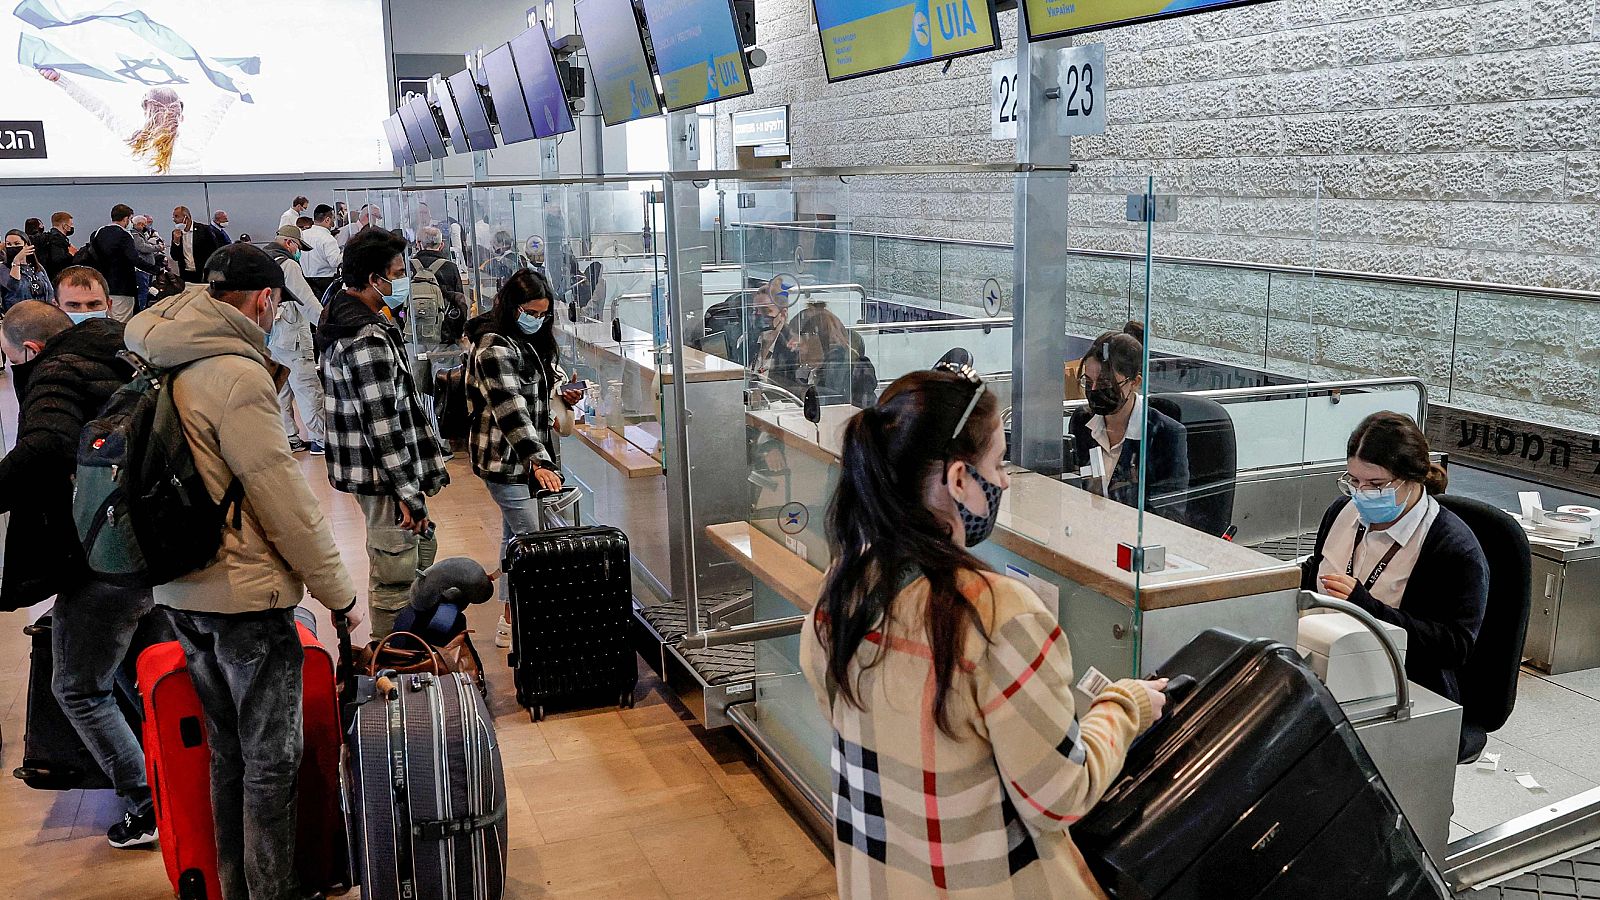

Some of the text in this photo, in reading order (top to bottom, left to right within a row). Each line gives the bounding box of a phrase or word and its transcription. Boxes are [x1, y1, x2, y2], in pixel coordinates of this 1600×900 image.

[937, 0, 977, 41] UIA
[718, 60, 740, 87] UIA
[1067, 63, 1093, 116] 23
[688, 123, 696, 151] 21
[1457, 420, 1571, 468] המסוע
[394, 750, 404, 788] alanti
